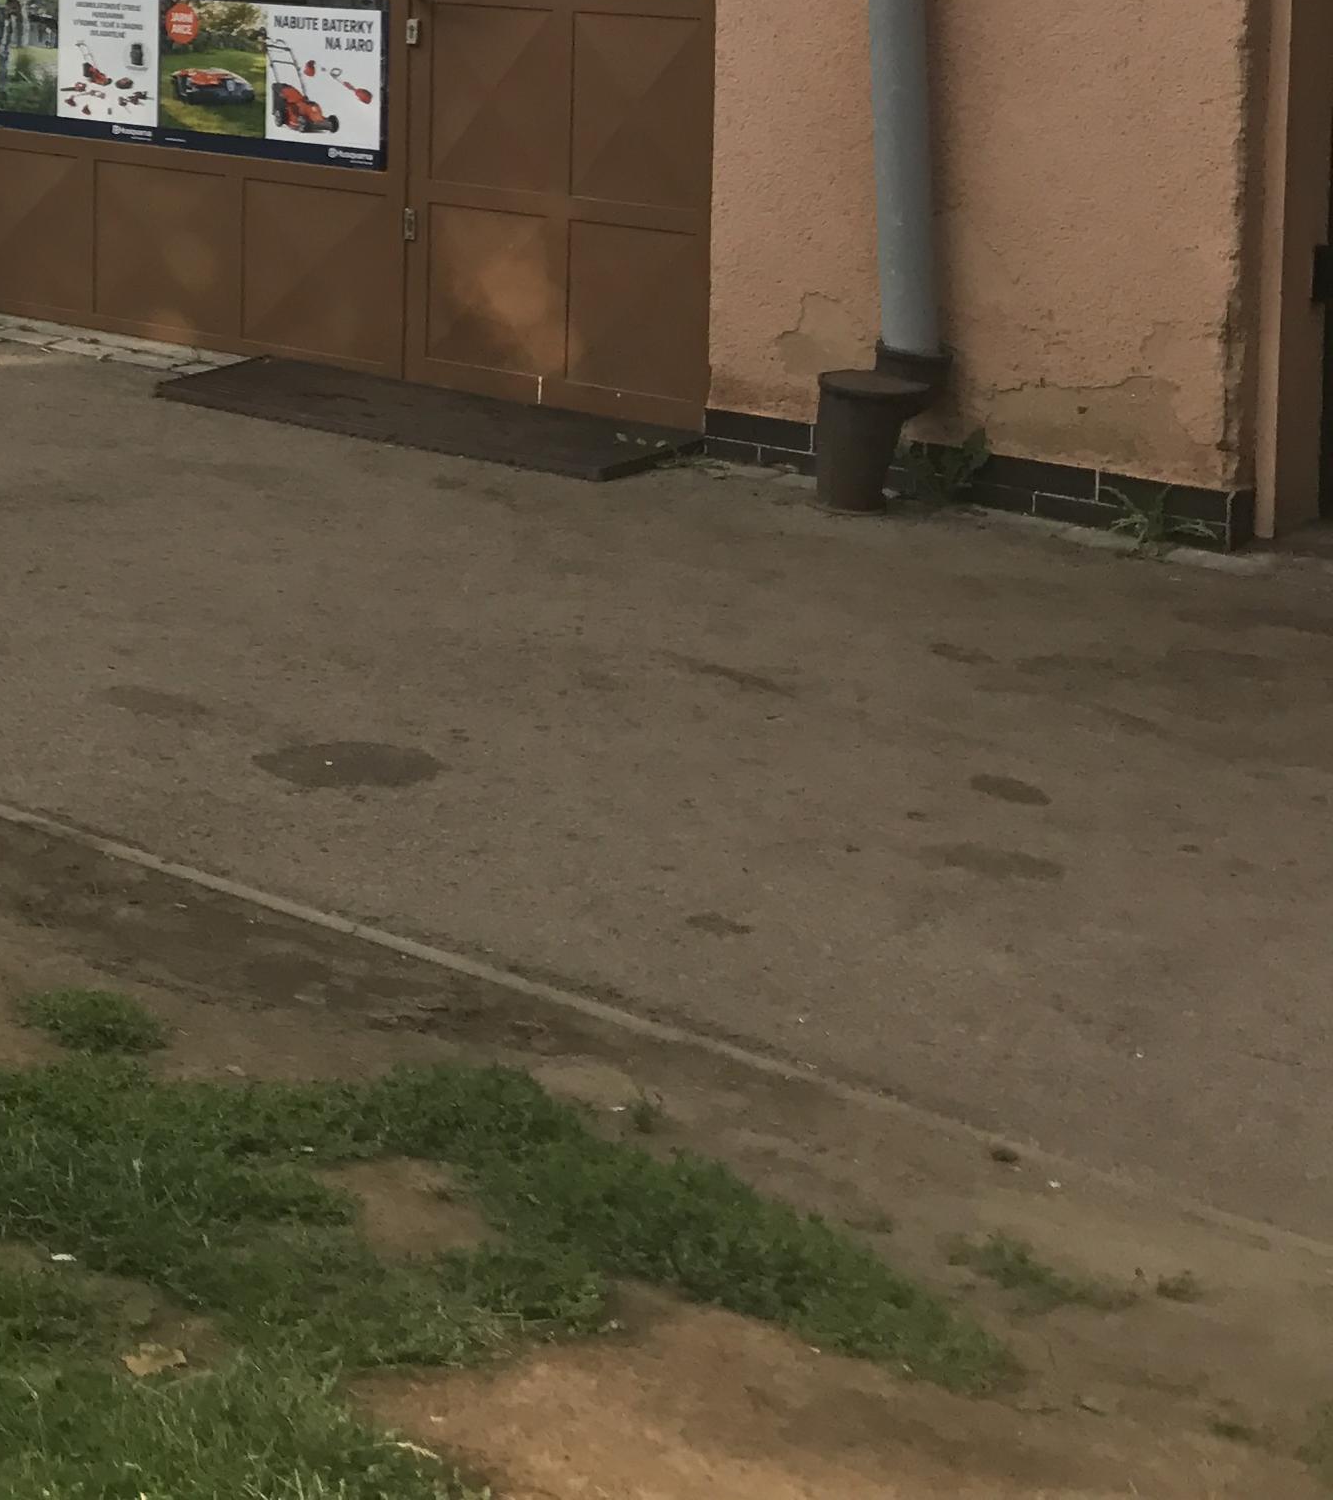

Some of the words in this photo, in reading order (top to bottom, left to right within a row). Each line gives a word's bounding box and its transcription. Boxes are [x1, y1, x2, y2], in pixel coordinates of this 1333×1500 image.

[322, 18, 374, 34] BATERKY
[325, 37, 342, 51] NA
[345, 38, 374, 52] JARO
